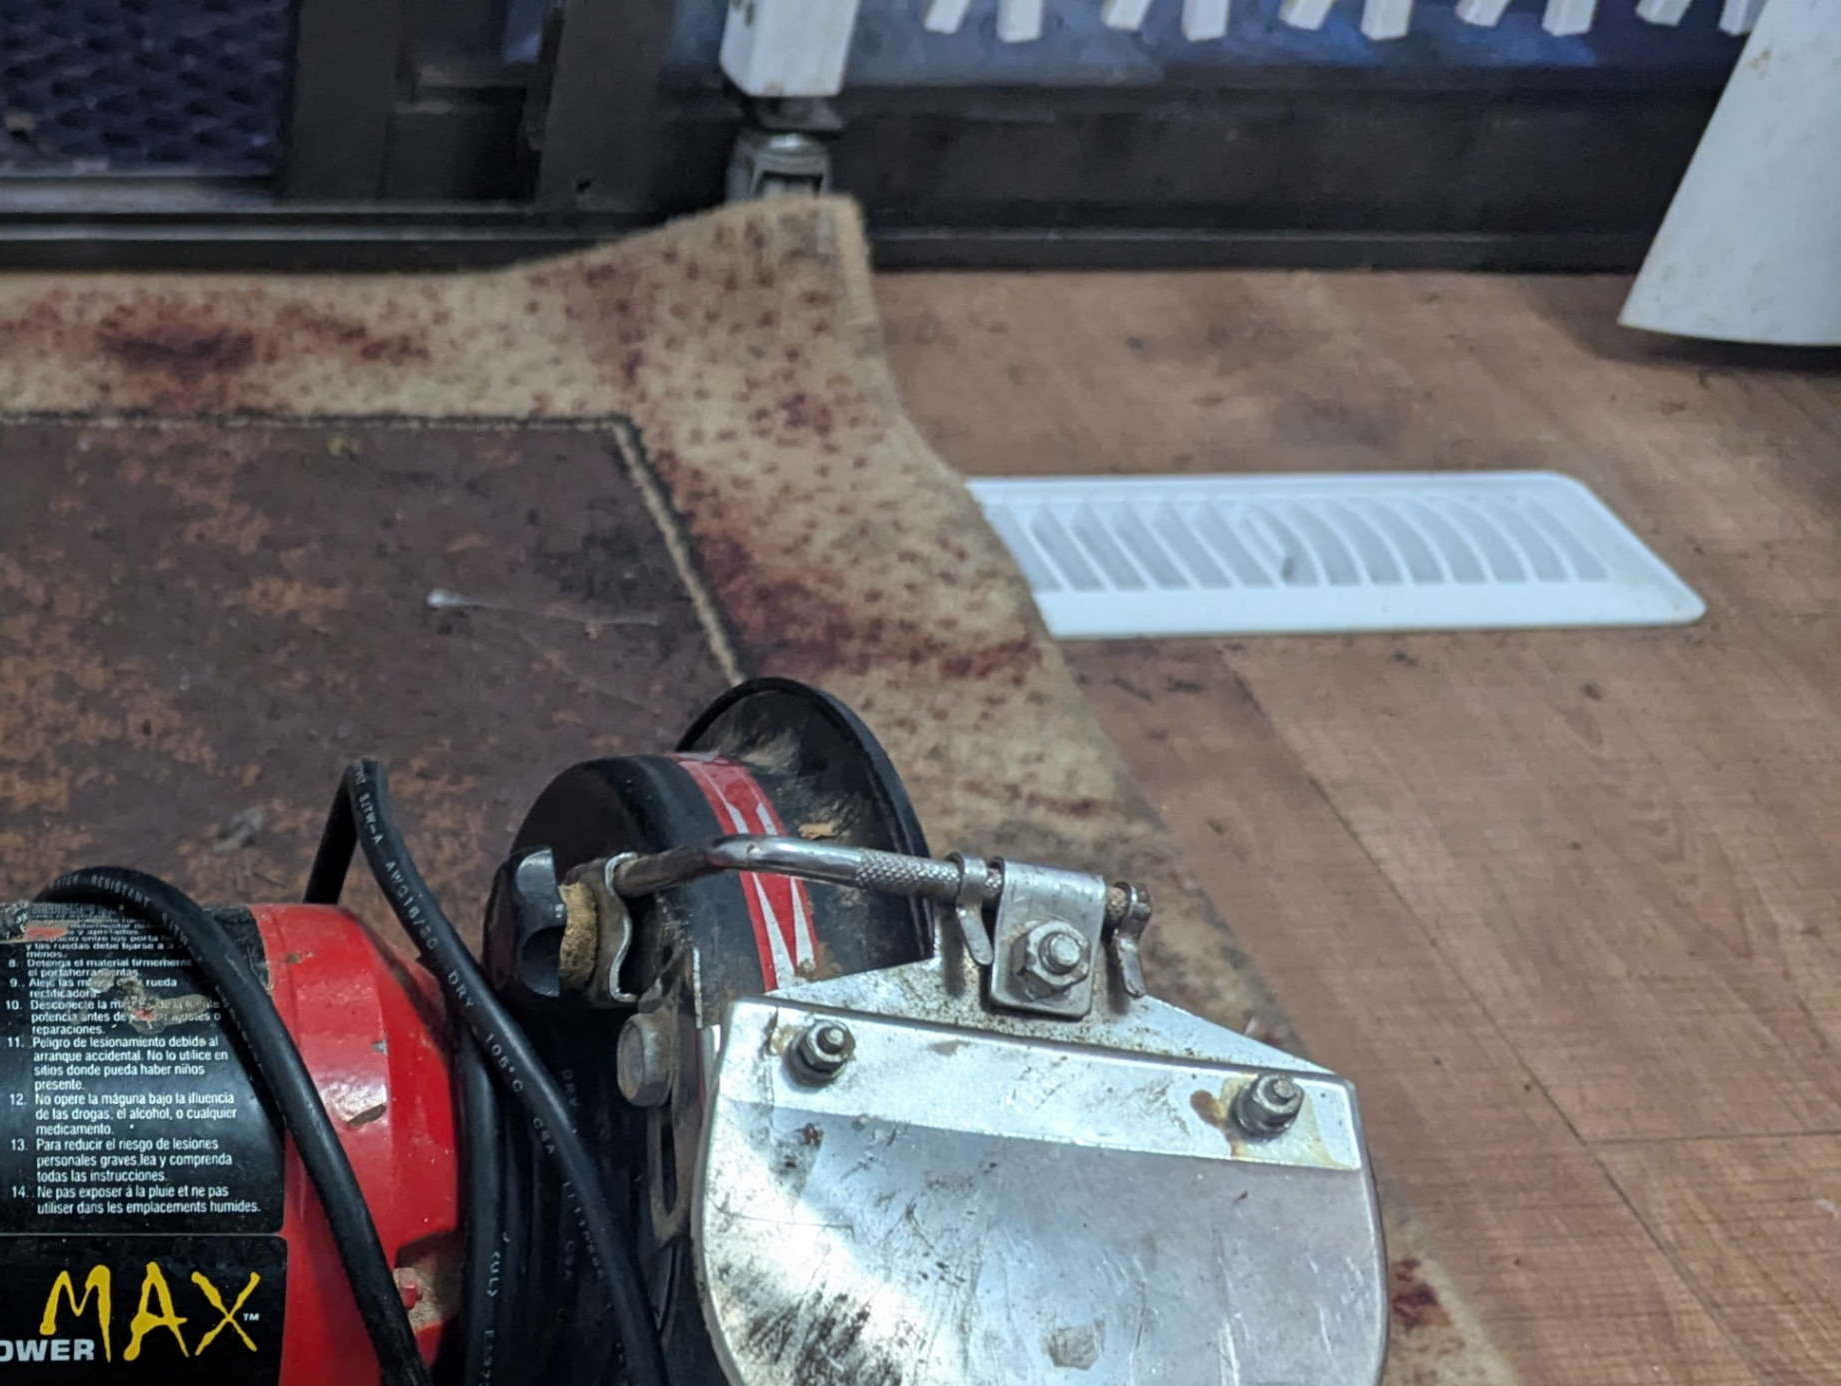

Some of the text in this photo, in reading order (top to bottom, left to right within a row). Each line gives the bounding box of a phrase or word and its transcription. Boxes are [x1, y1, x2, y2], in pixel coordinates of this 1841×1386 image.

[27, 959, 129, 969] Detenga el material
[28, 969, 37, 977] el
[59, 978, 74, 987] las
[146, 978, 177, 987] rueda
[448, 970, 475, 1008] DRY
[6, 1001, 22, 1010] 10.
[30, 1001, 94, 1010] Desconecte
[98, 1001, 107, 1010] la
[114, 1013, 126, 1022] de
[32, 1025, 106, 1036] reparaciones.
[8, 1037, 218, 1050] 11. Peligro de lesionamiento al
[34, 1050, 228, 1062] arranque accidental. No lo utilice en
[34, 1065, 64, 1076] sitios
[67, 1065, 101, 1076] donde
[104, 1065, 137, 1078] pueda
[141, 1064, 171, 1075] haber
[35, 1079, 85, 1092] presente.
[10, 1093, 185, 1107] 12. No opere la bajo la
[36, 1107, 237, 1120] de las el alcohol, o cualquier
[36, 1123, 114, 1135] medicamento.
[11, 1138, 218, 1152] 13. Para reducir el riesgo de lesiones
[37, 1154, 232, 1168] personales y comprenda
[37, 1170, 167, 1182] todas las instrucciones.
[13, 1185, 229, 1200] 14. Ne pas exposer la pluie et ne pas
[38, 1200, 261, 1215] utiliser dans les emplacements humides.
[40, 1262, 260, 1362] MAX
